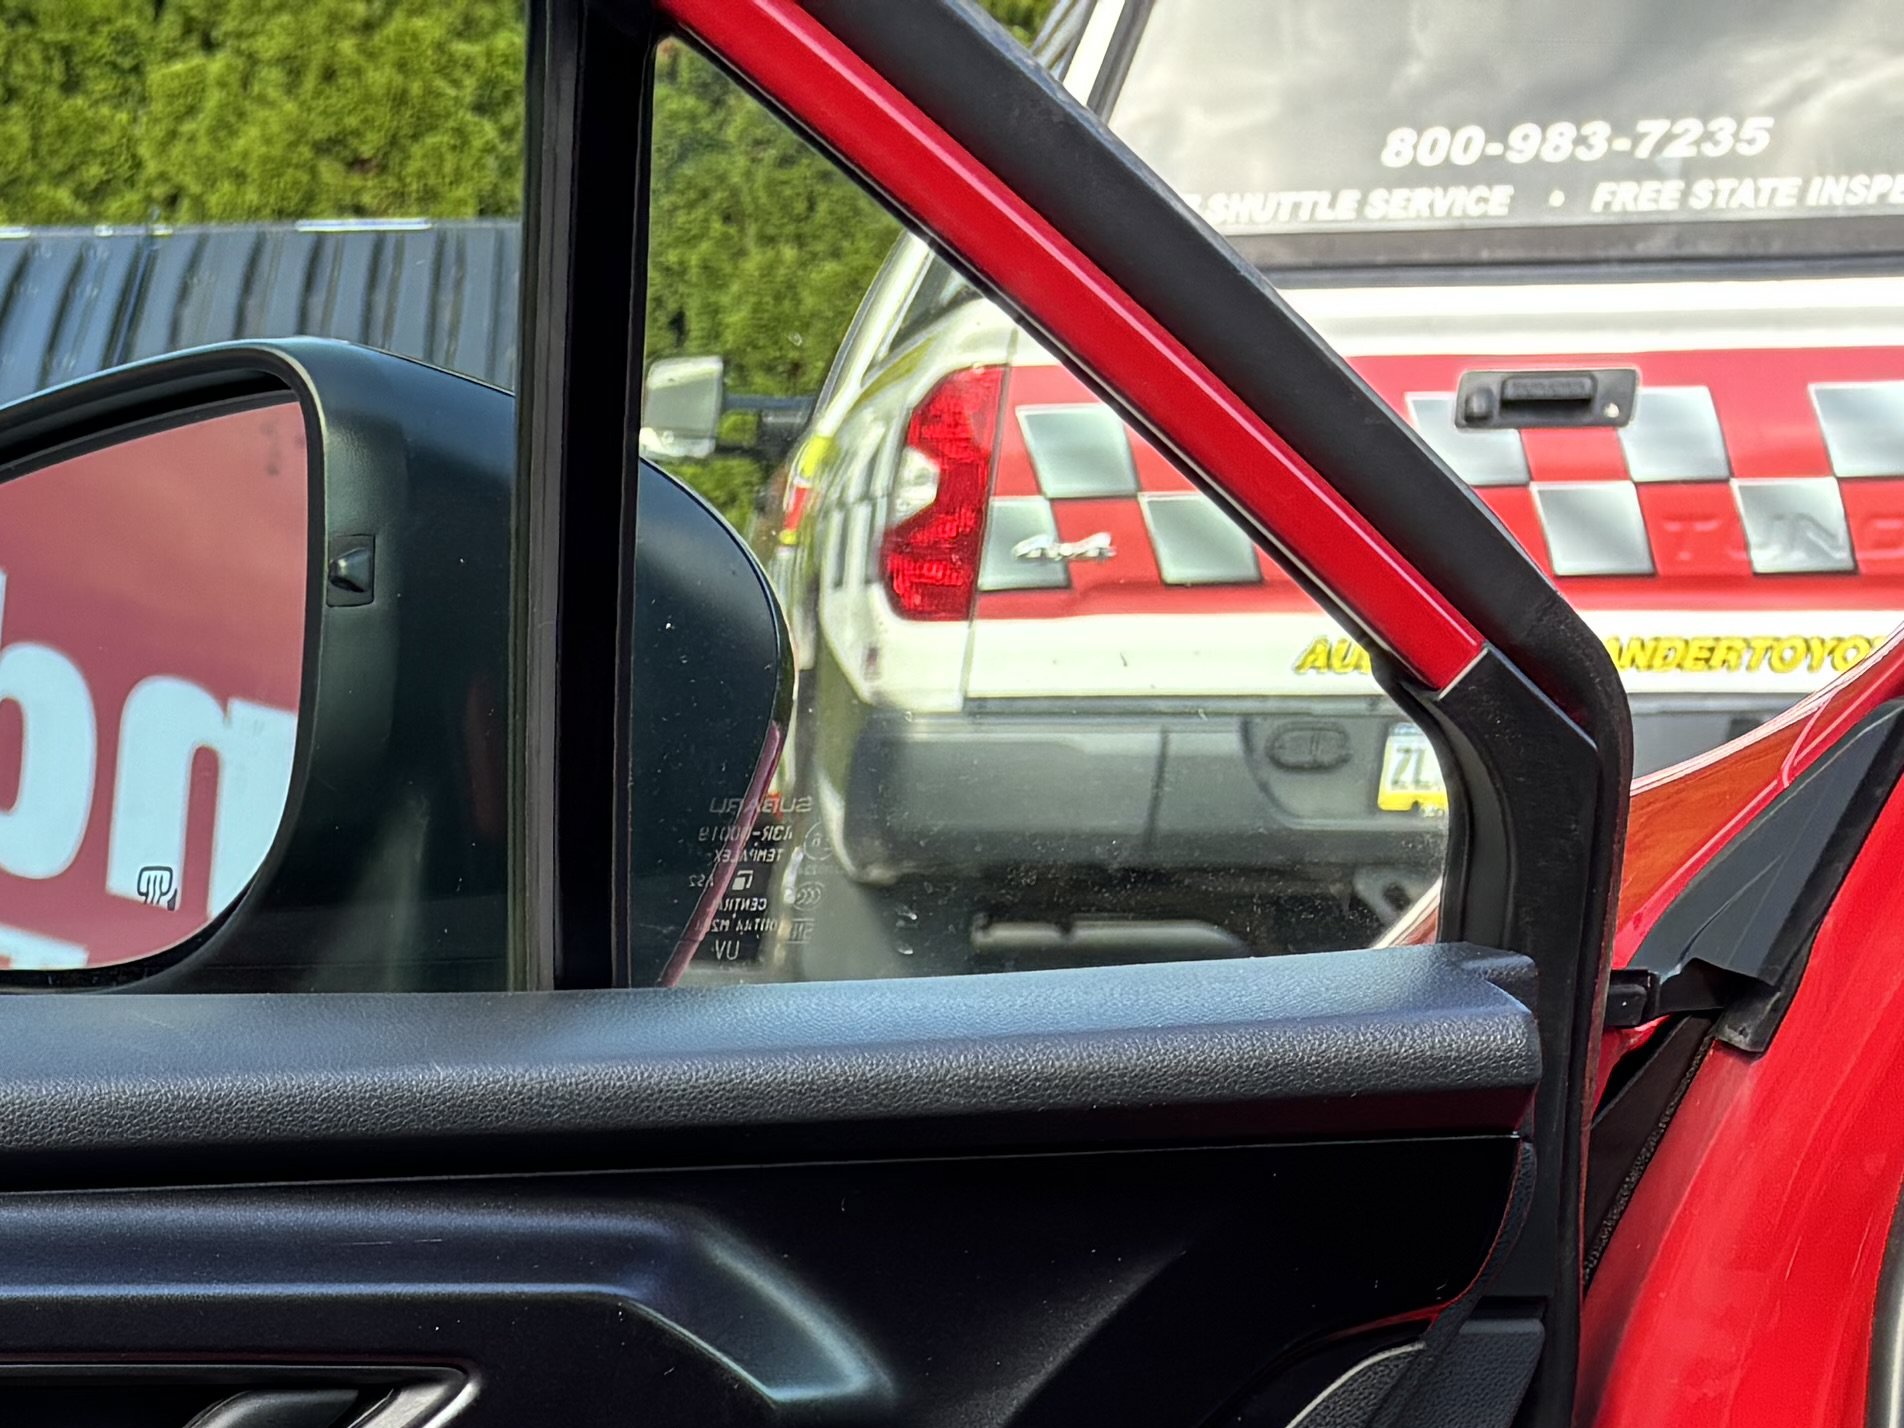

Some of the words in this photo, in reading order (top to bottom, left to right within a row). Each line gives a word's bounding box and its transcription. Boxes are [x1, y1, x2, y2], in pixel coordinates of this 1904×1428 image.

[1380, 116, 1775, 169] 800-983-7235
[1202, 189, 1362, 224] SHUTTLE
[1363, 184, 1515, 219] SERVICE
[1590, 179, 1686, 213] FREE
[1688, 176, 1803, 210] STATE
